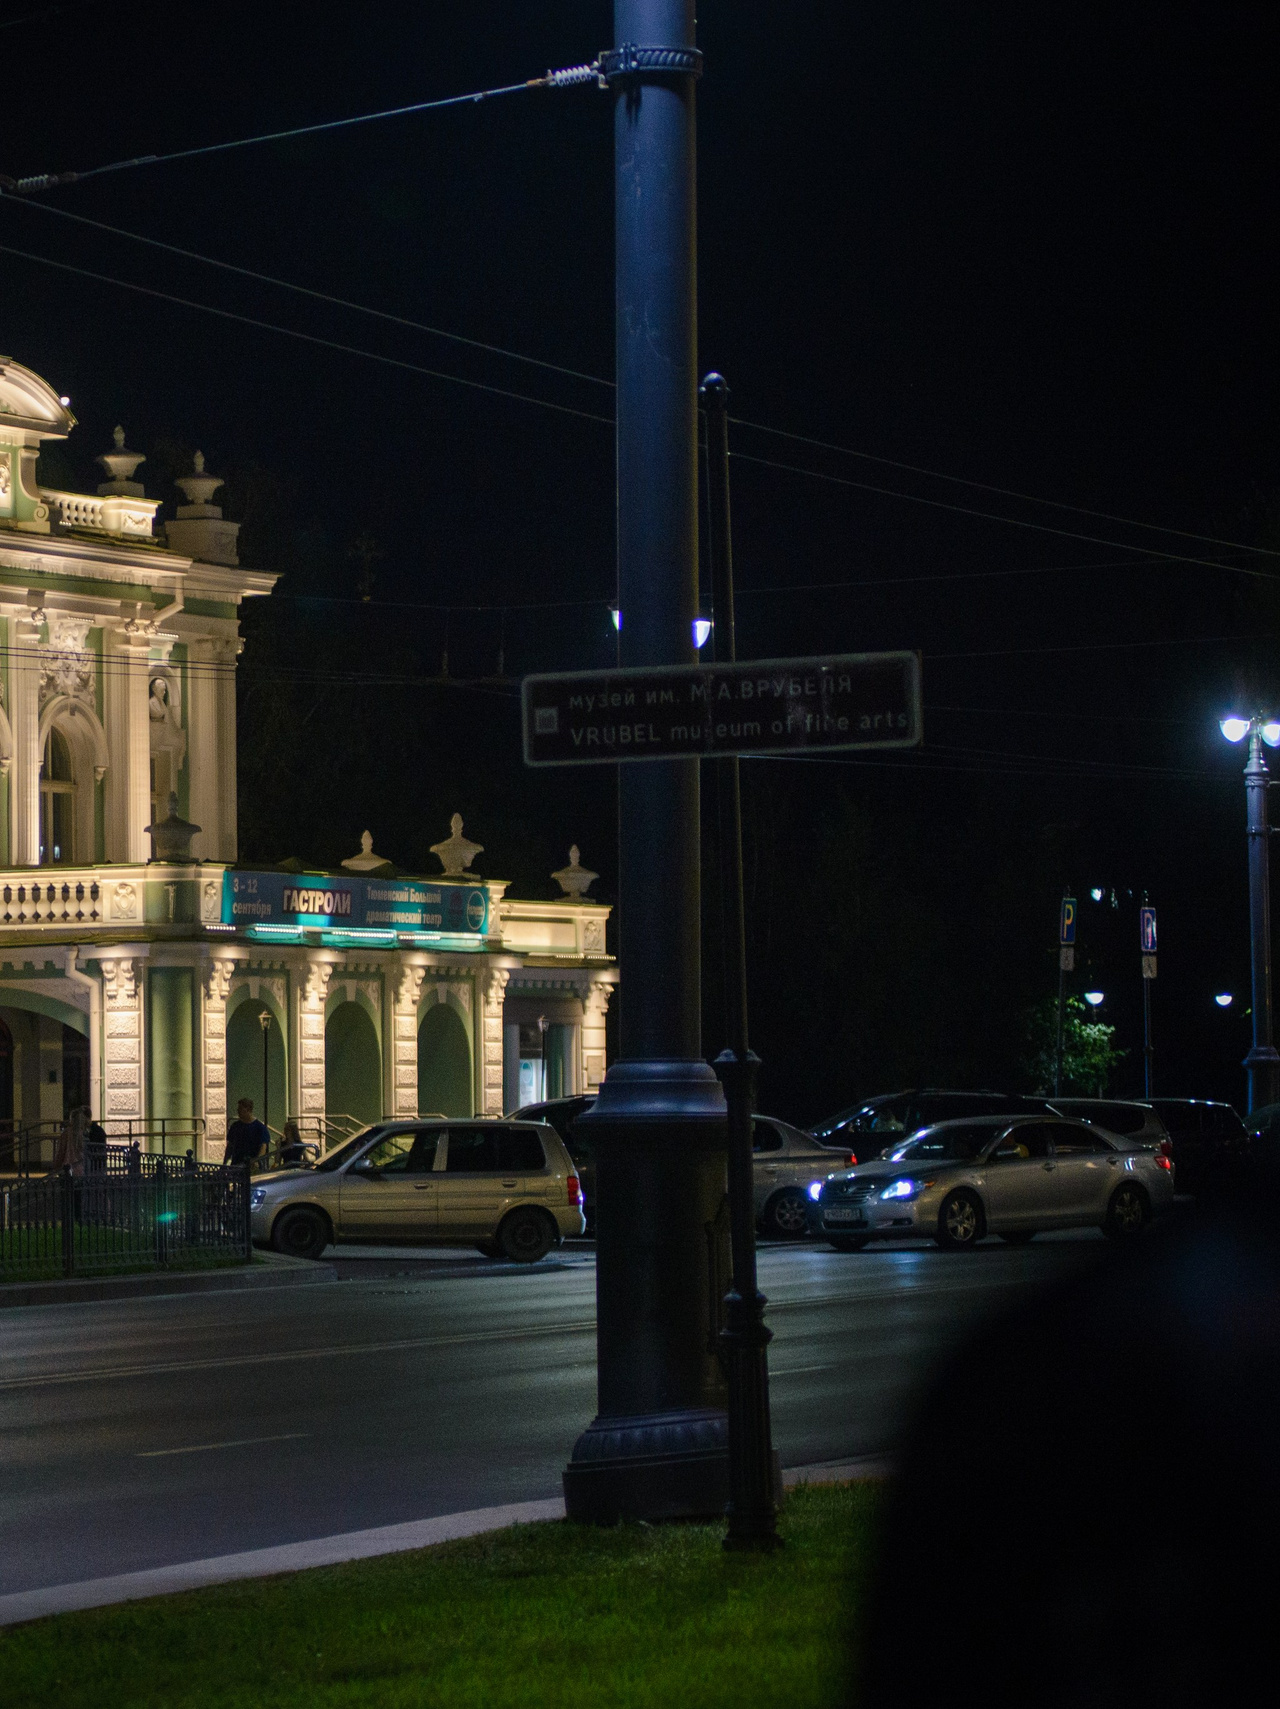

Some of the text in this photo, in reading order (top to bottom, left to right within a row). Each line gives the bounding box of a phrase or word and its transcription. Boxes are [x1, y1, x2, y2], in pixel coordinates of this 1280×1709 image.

[568, 688, 636, 713] музей
[645, 688, 681, 705] им.
[570, 723, 662, 746] VRUBEL
[770, 713, 794, 734] of
[859, 710, 908, 729] arts
[232, 899, 272, 918] сентября
[283, 889, 351, 914] ГАСТРОЛИ
